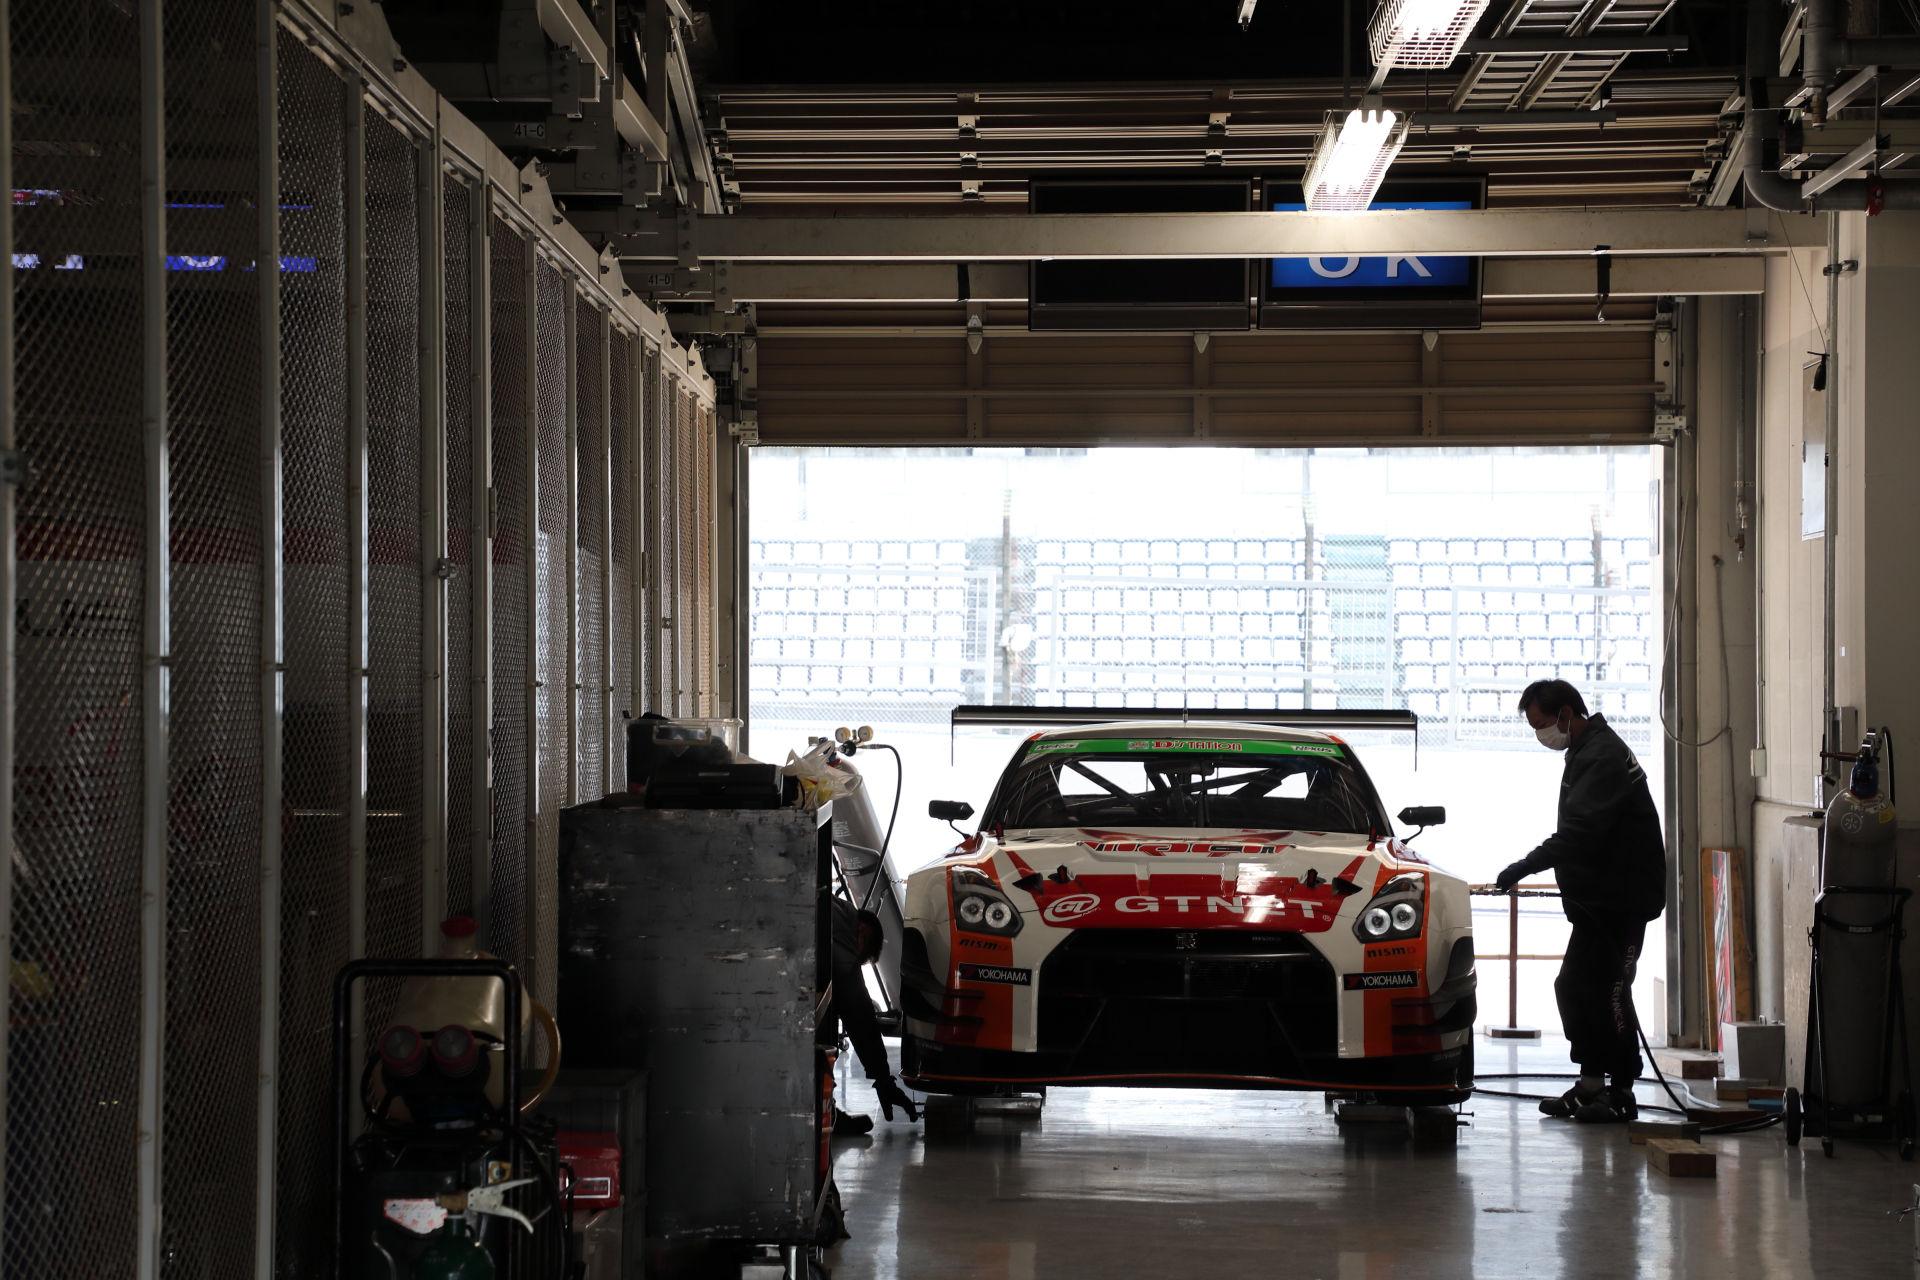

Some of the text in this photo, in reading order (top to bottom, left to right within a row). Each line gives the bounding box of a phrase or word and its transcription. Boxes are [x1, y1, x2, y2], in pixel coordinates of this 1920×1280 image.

[514, 123, 544, 137] 41-C
[648, 274, 671, 285] 41-D
[1114, 895, 1325, 920] GTNET
[977, 967, 1028, 983] YOKOHAMA
[1361, 974, 1414, 987] YOKOHAMA
[1610, 979, 1626, 1034] TECHNICAL
